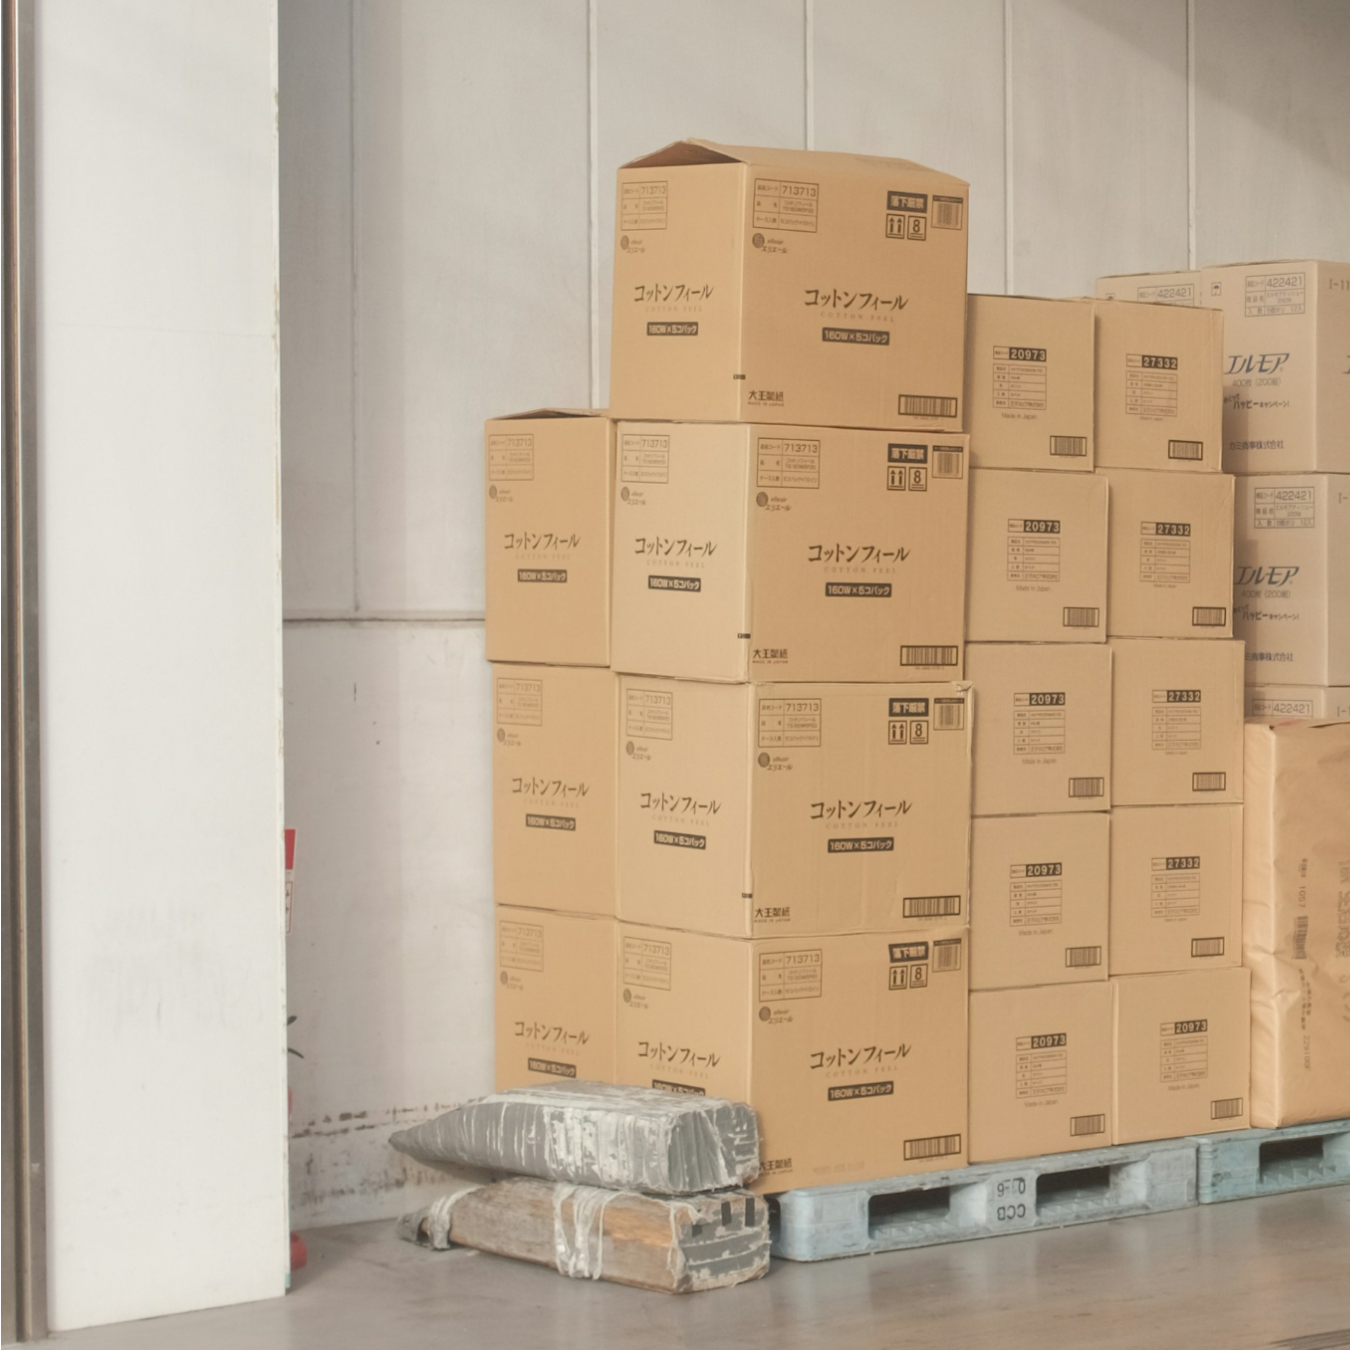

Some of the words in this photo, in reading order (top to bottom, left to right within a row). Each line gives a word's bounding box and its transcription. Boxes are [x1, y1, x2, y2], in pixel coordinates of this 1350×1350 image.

[641, 184, 666, 195] 713713
[782, 186, 816, 198] 713713
[912, 218, 921, 234] 8
[1266, 276, 1302, 288] 422421
[634, 282, 714, 303] コットンフィール
[1157, 287, 1192, 299] 422421
[804, 288, 909, 312] コットンフィール
[1010, 348, 1046, 361] 20973
[1143, 357, 1177, 369] 27332
[1223, 353, 1291, 375] エルモア
[748, 390, 784, 402] 大王製紙
[641, 438, 668, 449] 713713
[784, 442, 818, 454] 713713
[913, 470, 922, 484] 8
[1275, 489, 1312, 502] 422421
[1025, 521, 1060, 533] 20973
[1157, 524, 1190, 536] 27332
[504, 531, 582, 550] コットンフィール
[634, 536, 717, 558] コットンフィール
[807, 543, 911, 564] コットンフィール
[1234, 566, 1300, 586] エルモア
[752, 648, 789, 660] 大王製紙
[1244, 652, 1294, 662] ミ商事株式会社
[645, 693, 672, 706] 713713
[1031, 693, 1065, 705] 20973
[1168, 691, 1200, 702] 27332
[785, 702, 819, 713] 713713
[1274, 703, 1311, 714] 422421
[914, 722, 923, 737] 8
[512, 776, 589, 798] コットンフィール
[640, 791, 721, 817] コットンフィール
[810, 799, 912, 821] コットンフィール
[1027, 863, 1061, 876] 20973
[1167, 857, 1200, 869] 27332
[754, 907, 790, 919] 大王製紙
[642, 943, 670, 957] 713713
[785, 953, 820, 965] 713713
[914, 967, 923, 982] 8
[514, 1021, 590, 1047] コットンフィール
[1175, 1021, 1207, 1034] 20973
[1033, 1034, 1066, 1048] 20973
[637, 1041, 720, 1069] コットンフィール
[809, 1042, 912, 1070] コットンフィール
[997, 1203, 1026, 1222] CCB
